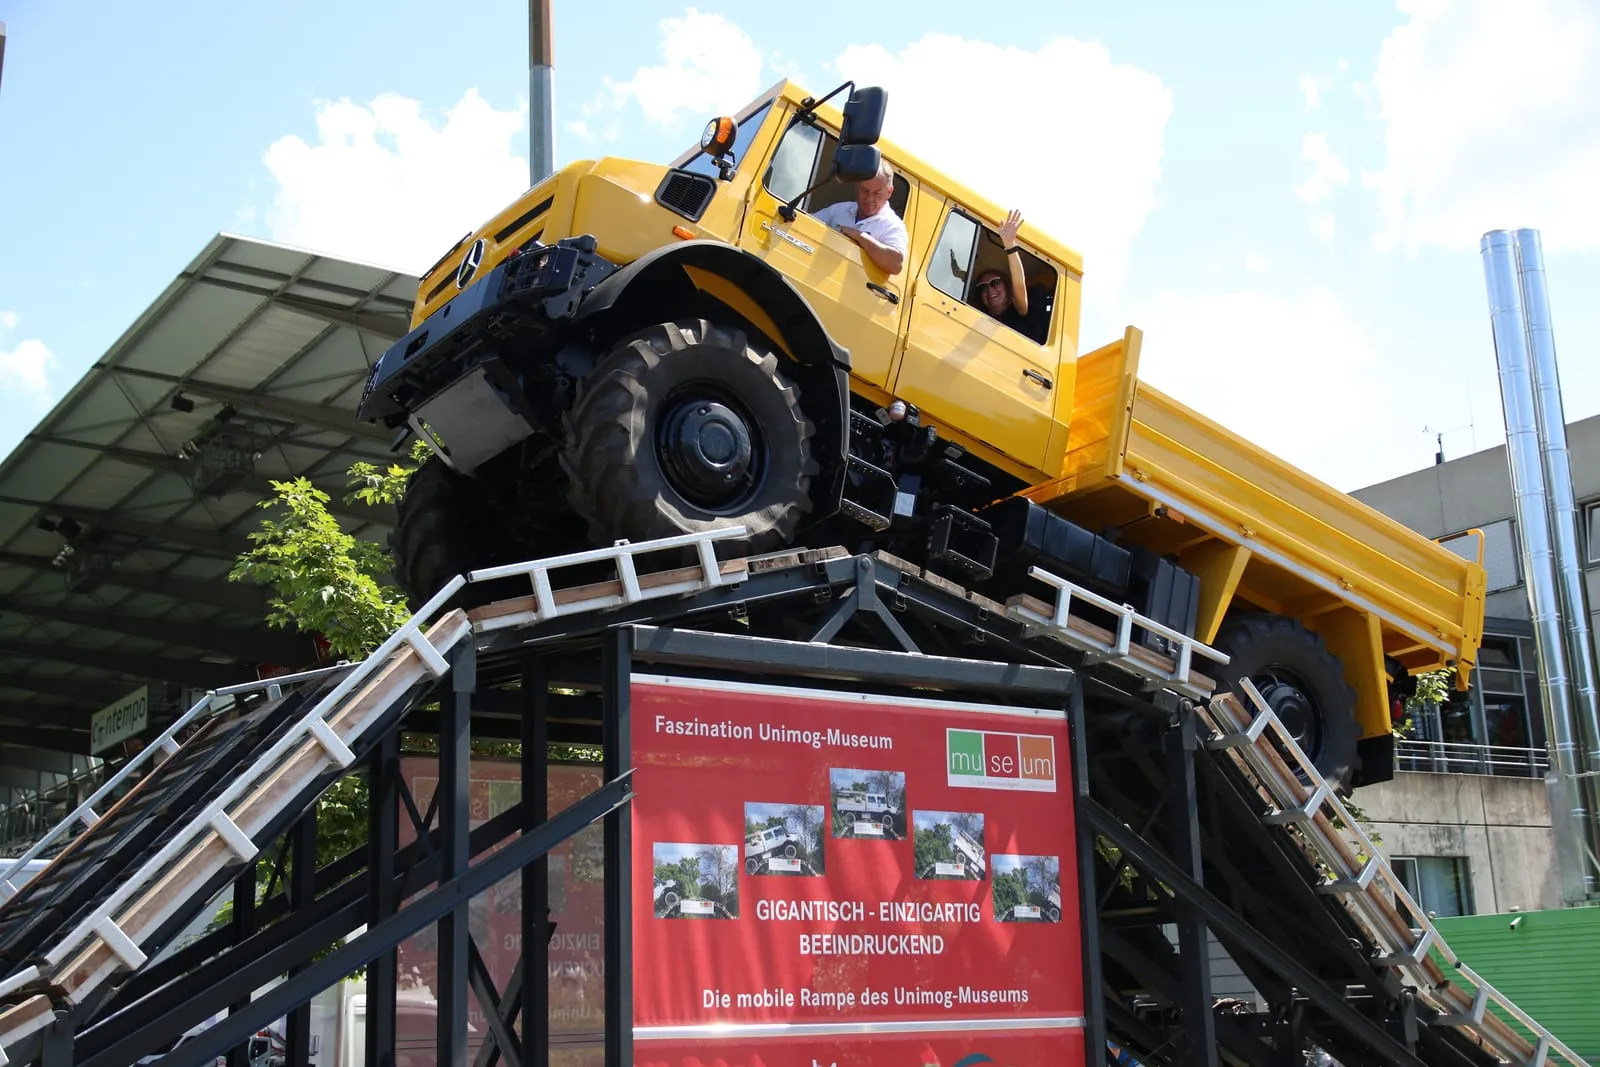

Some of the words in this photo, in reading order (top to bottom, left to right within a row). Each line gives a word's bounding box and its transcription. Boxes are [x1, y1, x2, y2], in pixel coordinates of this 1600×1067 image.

[655, 715, 753, 740] Faszination
[759, 723, 893, 749] Unimog-Museum
[756, 900, 865, 922] GIGANTISCH
[879, 902, 981, 923] EINZIGARTIG
[799, 934, 944, 955] BEEINDRUCKEND
[703, 989, 731, 1008] Die
[737, 988, 795, 1008] mobile
[800, 988, 855, 1010] Rampe
[861, 987, 889, 1006] des
[894, 986, 1029, 1008] Unimog-Museums
